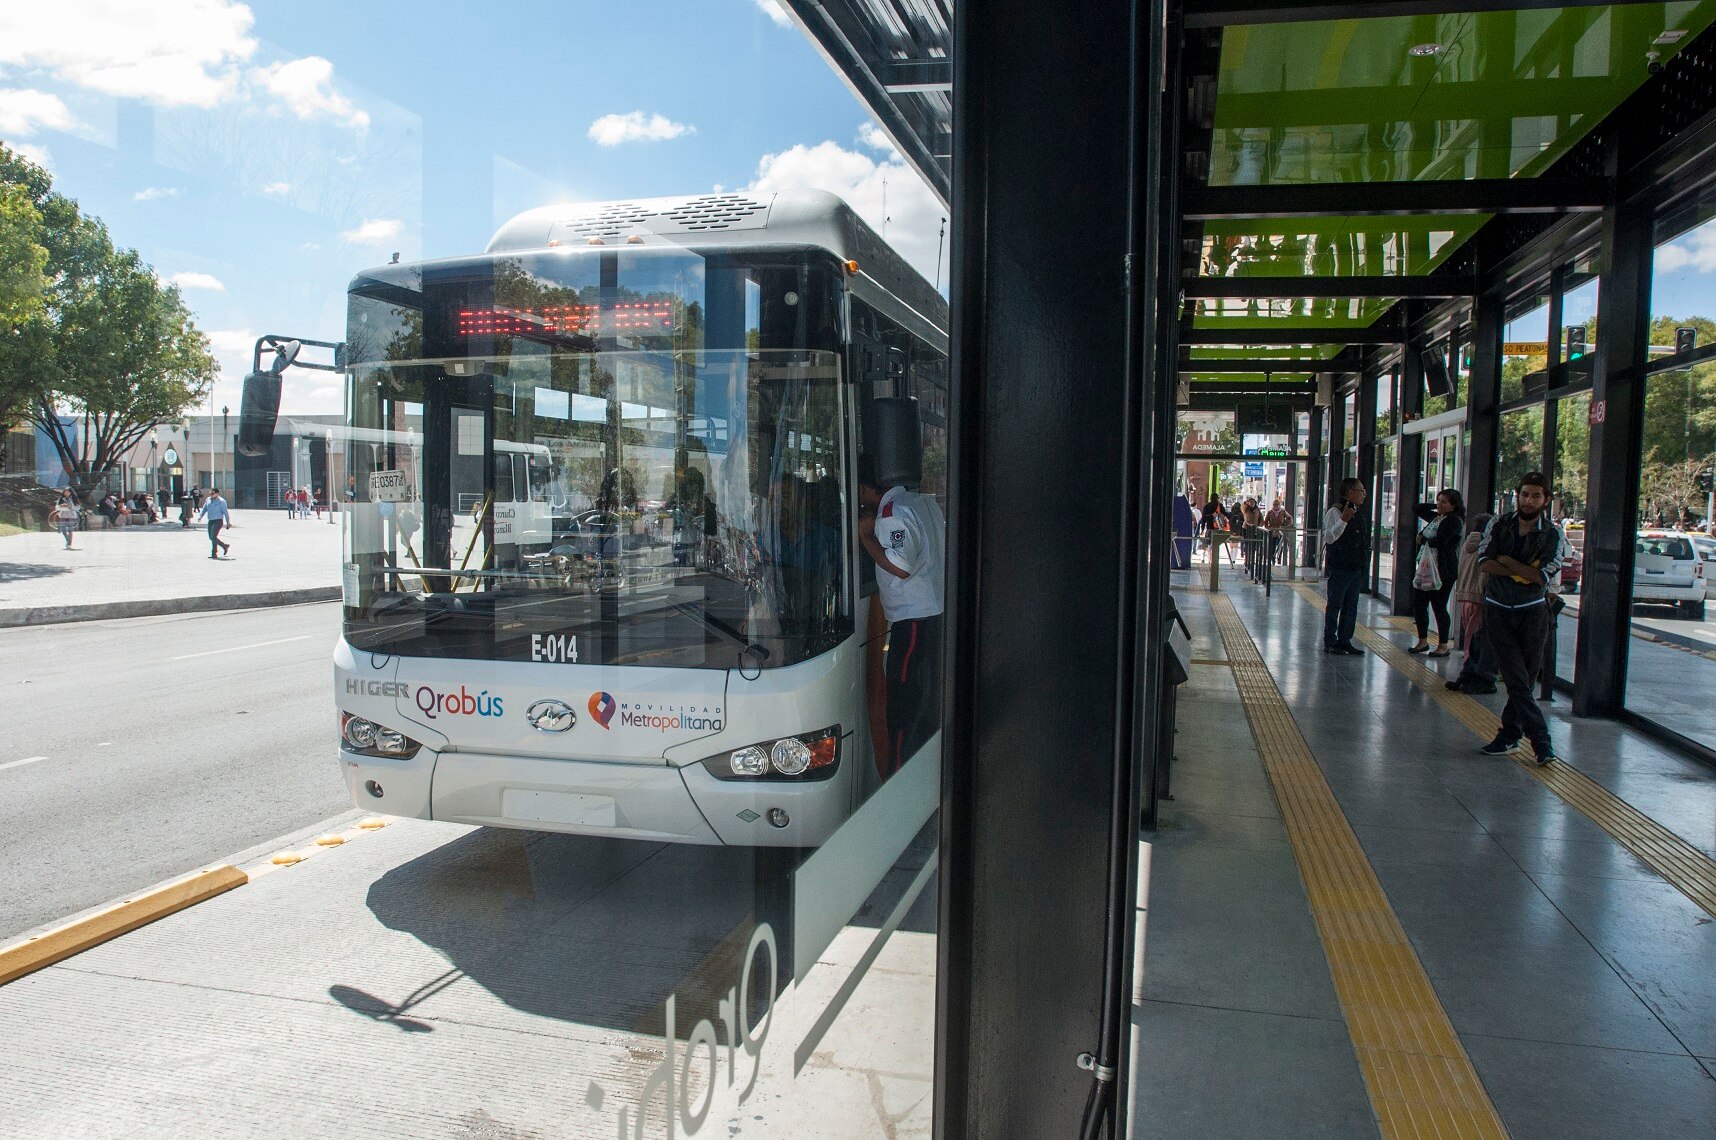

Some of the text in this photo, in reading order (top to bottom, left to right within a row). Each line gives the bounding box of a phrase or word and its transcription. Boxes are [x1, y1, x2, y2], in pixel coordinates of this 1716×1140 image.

[531, 633, 578, 663] E-014
[346, 679, 410, 699] HIGER
[415, 685, 504, 720] Qrobús
[621, 703, 721, 714] MOVILIDAD
[621, 711, 722, 734] Metropolitana
